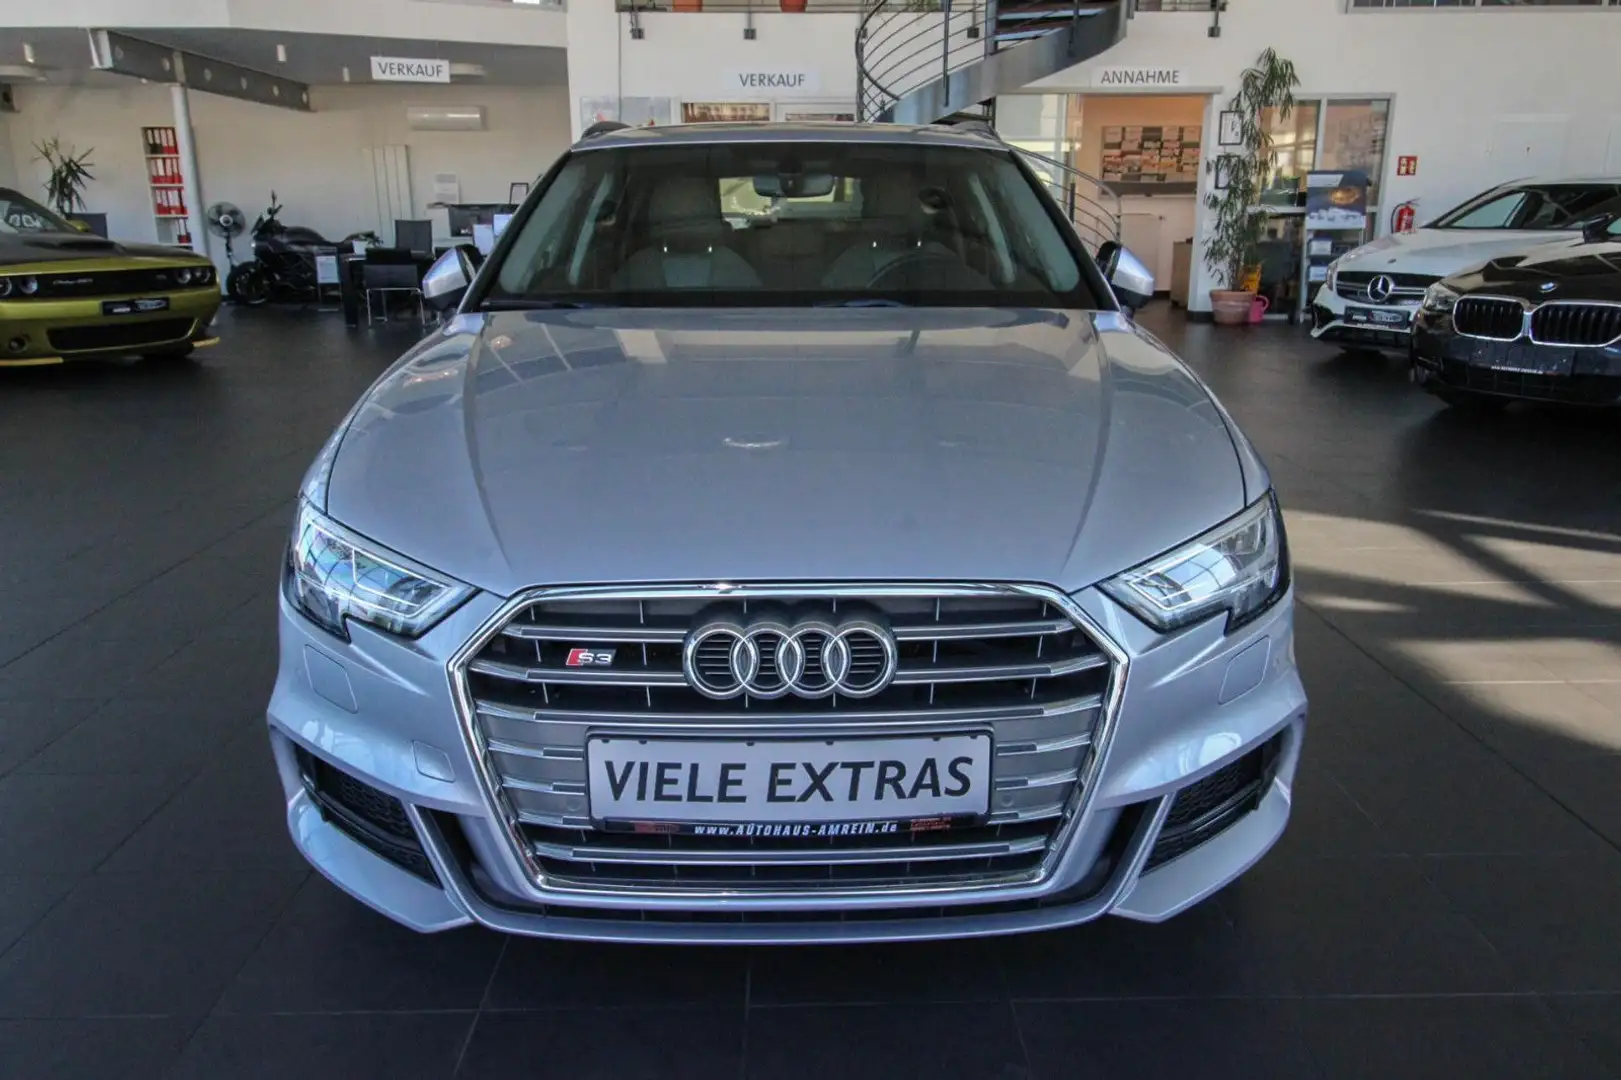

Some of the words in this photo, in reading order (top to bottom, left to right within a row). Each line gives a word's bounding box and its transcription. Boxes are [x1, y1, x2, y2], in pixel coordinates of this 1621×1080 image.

[378, 62, 443, 77] VERKAUF
[1101, 70, 1180, 84] ANNAHME
[739, 73, 806, 88] VERKAUF
[577, 652, 613, 665] S3
[604, 760, 748, 803] VIELE
[765, 756, 974, 803] EXTRAS
[694, 821, 898, 836] www.AUTOHAUS-AMREIN.de
